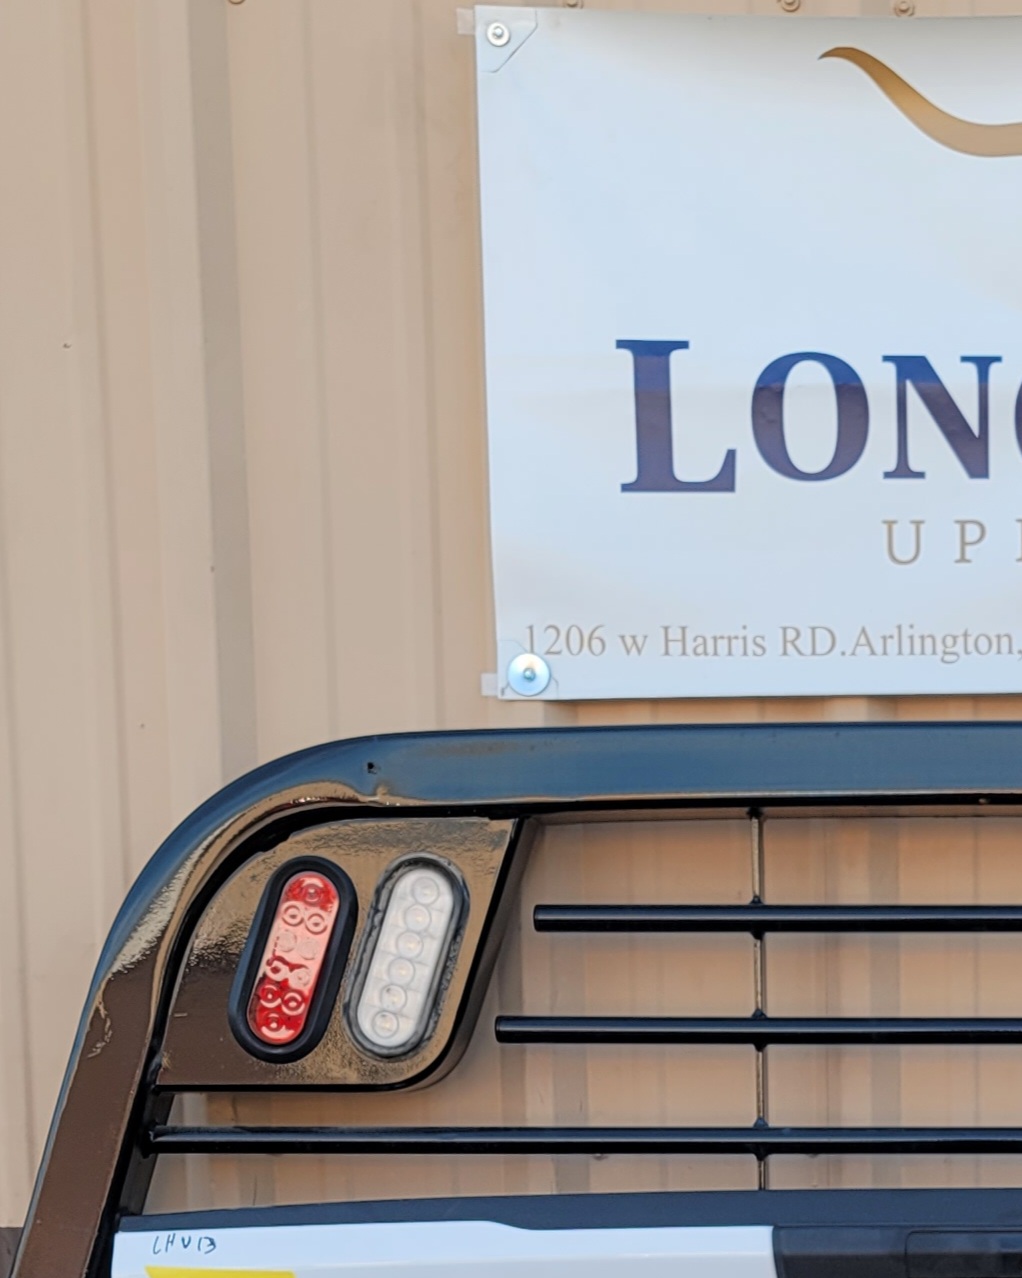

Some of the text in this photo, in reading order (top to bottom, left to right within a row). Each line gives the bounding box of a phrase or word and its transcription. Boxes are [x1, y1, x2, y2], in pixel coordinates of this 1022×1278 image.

[525, 624, 607, 656] 1206
[618, 634, 648, 656] w
[660, 624, 767, 657] Harris
